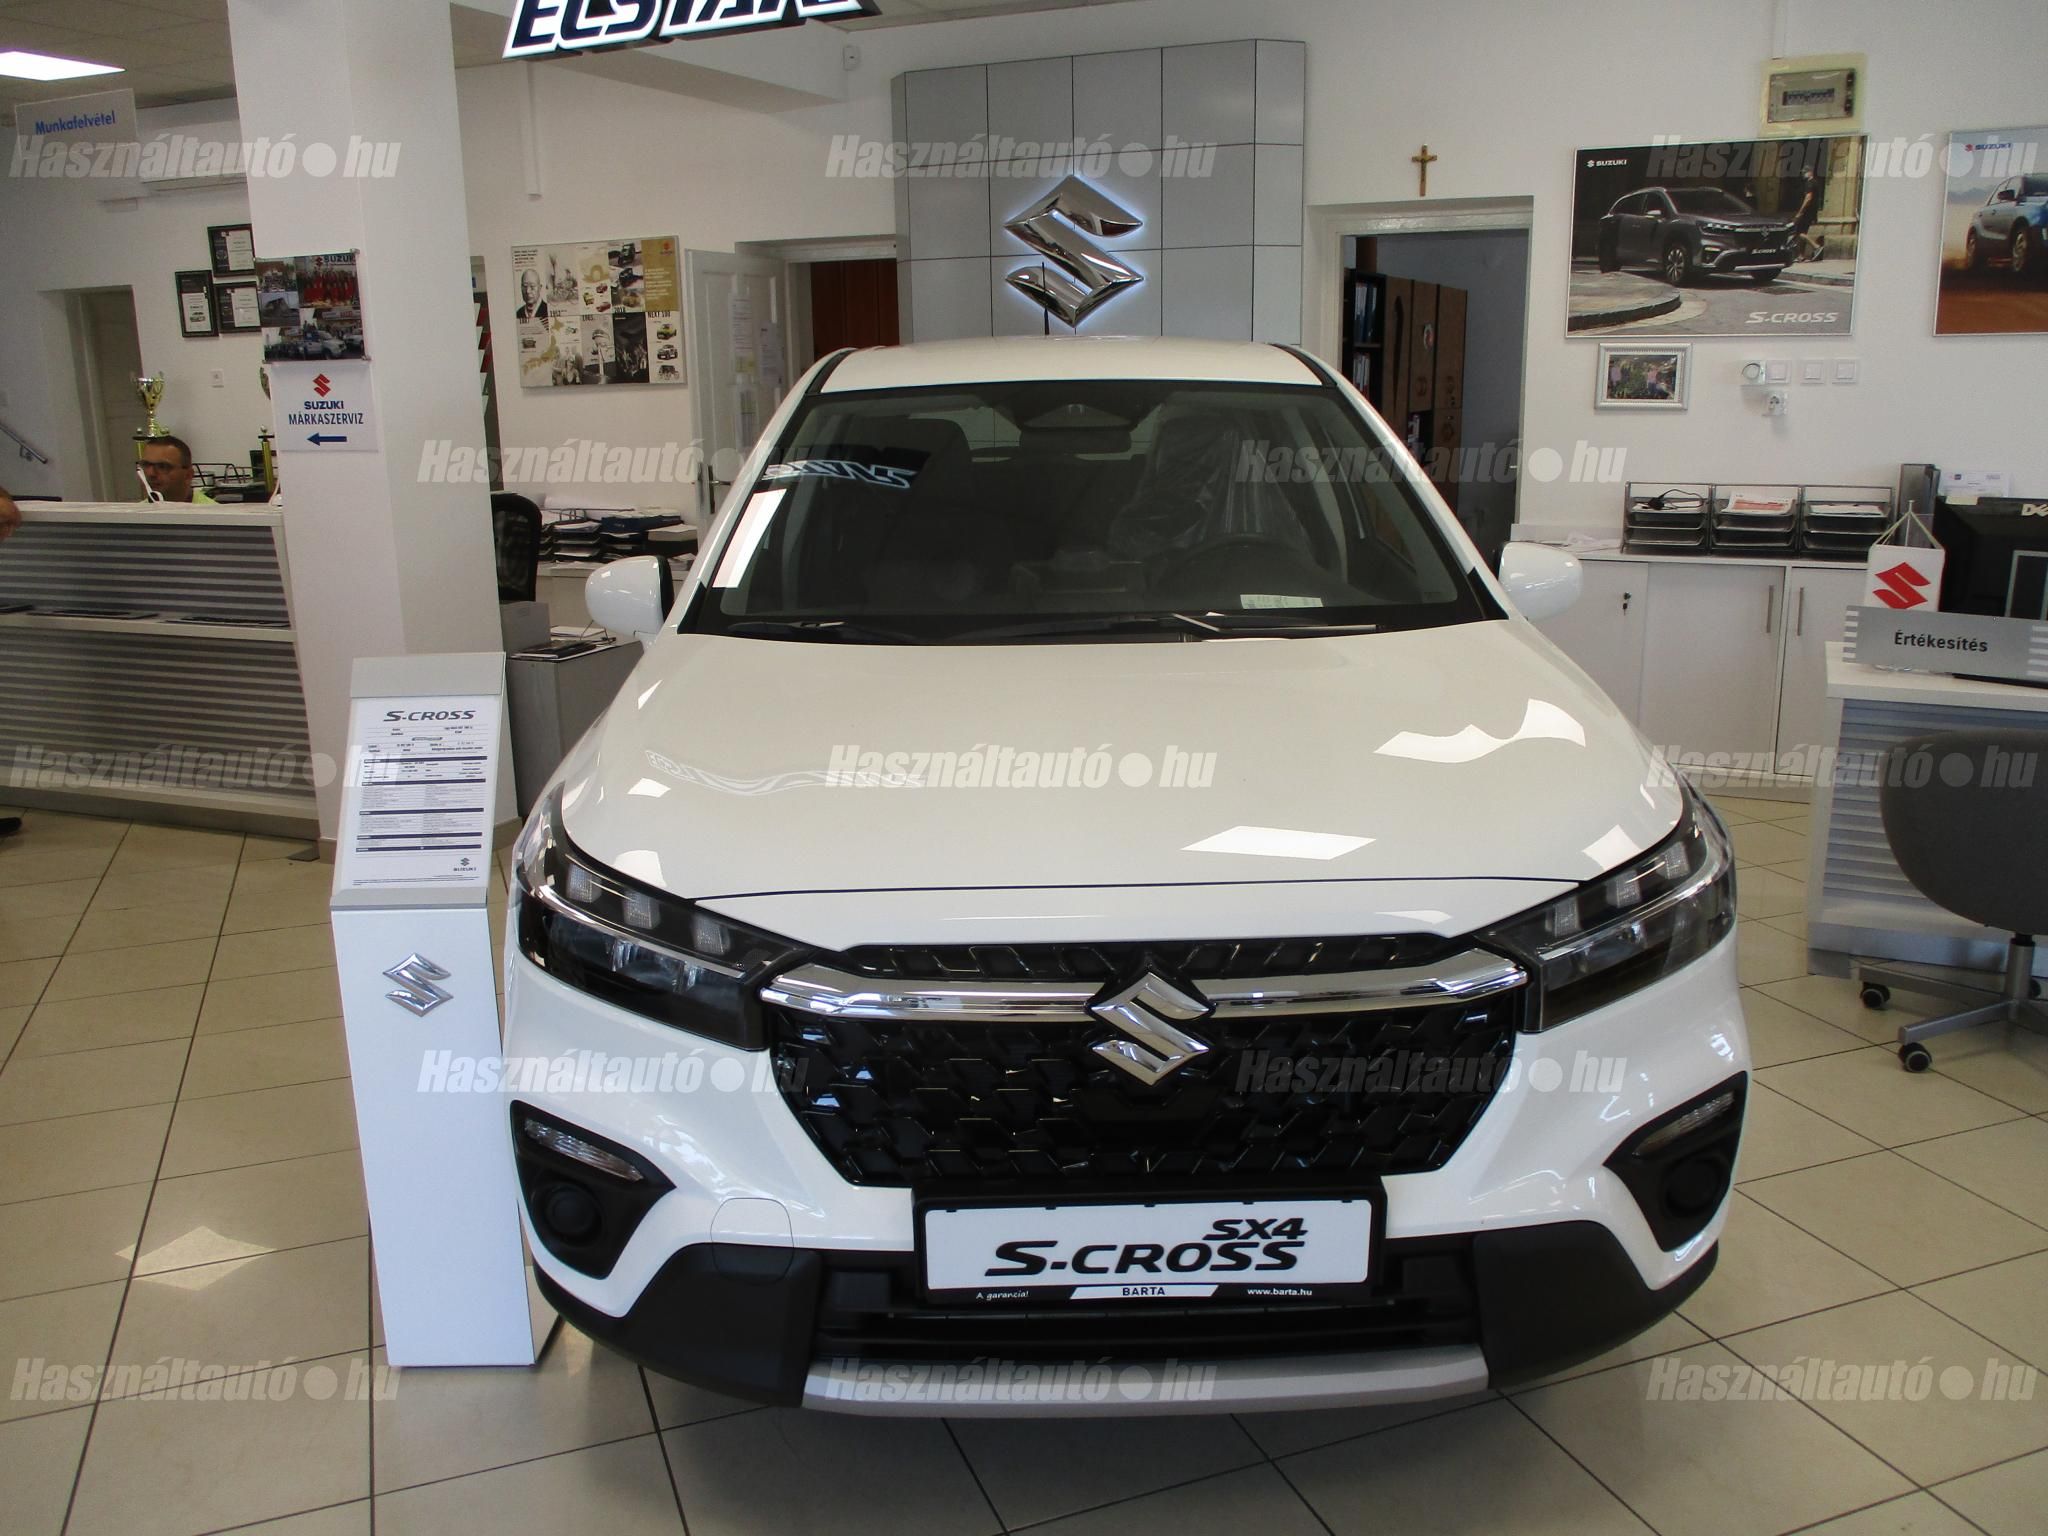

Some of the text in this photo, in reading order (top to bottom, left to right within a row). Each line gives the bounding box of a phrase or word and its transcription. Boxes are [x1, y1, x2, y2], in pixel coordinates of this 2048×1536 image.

[35, 110, 116, 136] Munkafelvétel
[1595, 159, 1628, 167] SUZUKI
[1745, 311, 1839, 324] S-CROSS
[304, 401, 344, 410] SUZUKI
[288, 411, 364, 426] MÁRKASZERVIZ
[1894, 629, 1989, 654] Értékesítés
[383, 711, 477, 722] S-CROSS
[1203, 1217, 1308, 1240] SX4
[984, 1240, 1305, 1276] S-CROSS
[976, 1290, 1029, 1301] A garancia!
[1122, 1286, 1166, 1297] BARTA
[1247, 1287, 1313, 1297] www.barta.hu
